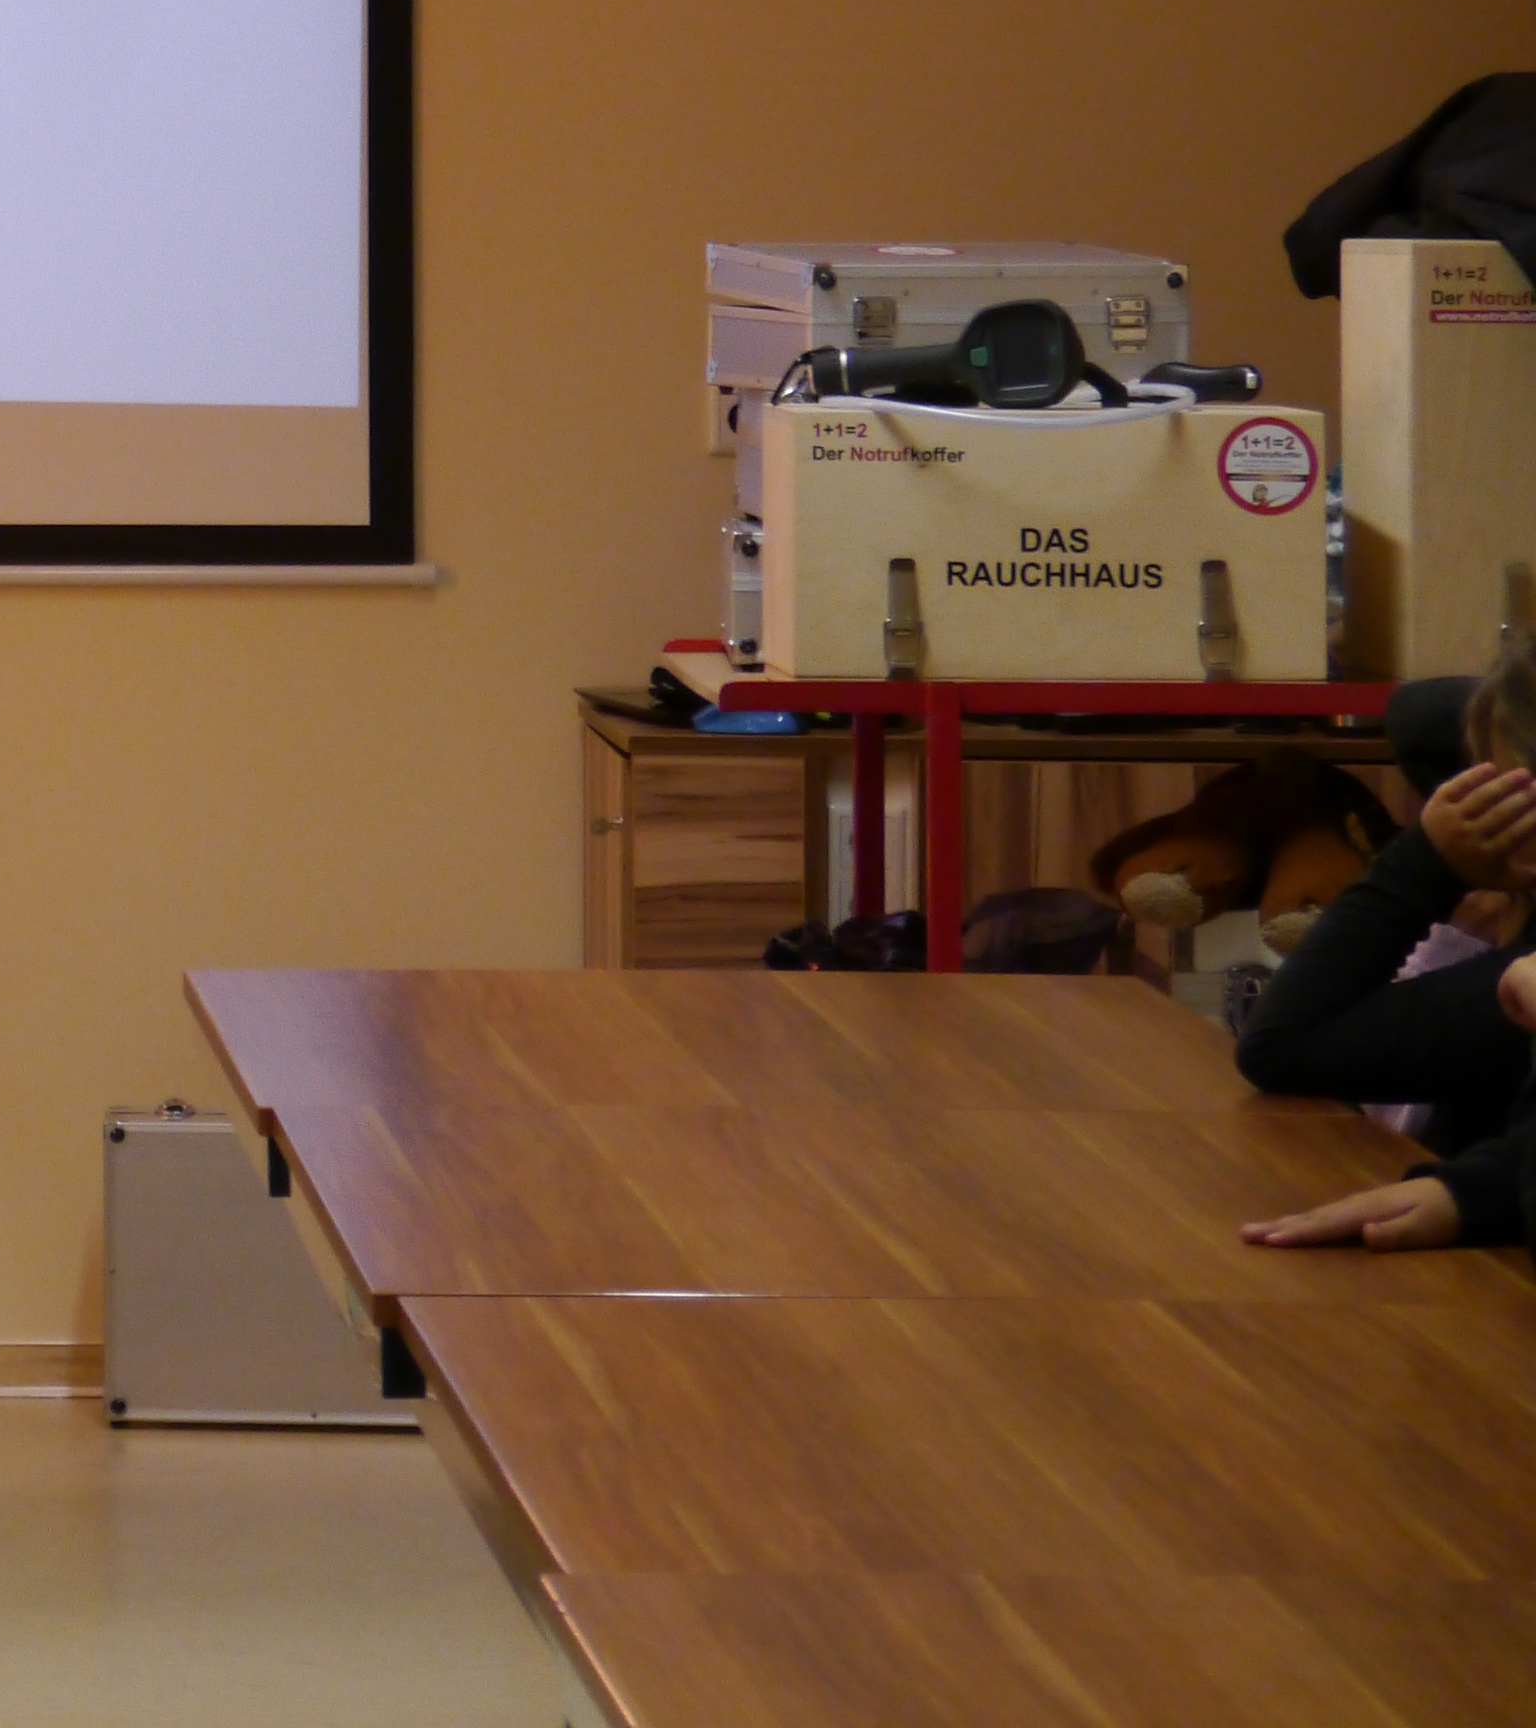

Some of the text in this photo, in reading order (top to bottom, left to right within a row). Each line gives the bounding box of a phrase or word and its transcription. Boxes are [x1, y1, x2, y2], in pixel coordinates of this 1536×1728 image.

[1433, 266, 1487, 282] 1+1=2
[1431, 290, 1463, 305] Der
[812, 423, 868, 438] 1+1=2
[1241, 435, 1295, 450] 1+1=2
[812, 445, 965, 462] Der Notrufkoffer
[1020, 528, 1090, 554] DAS
[946, 561, 1164, 589] RAUCHHAUS
